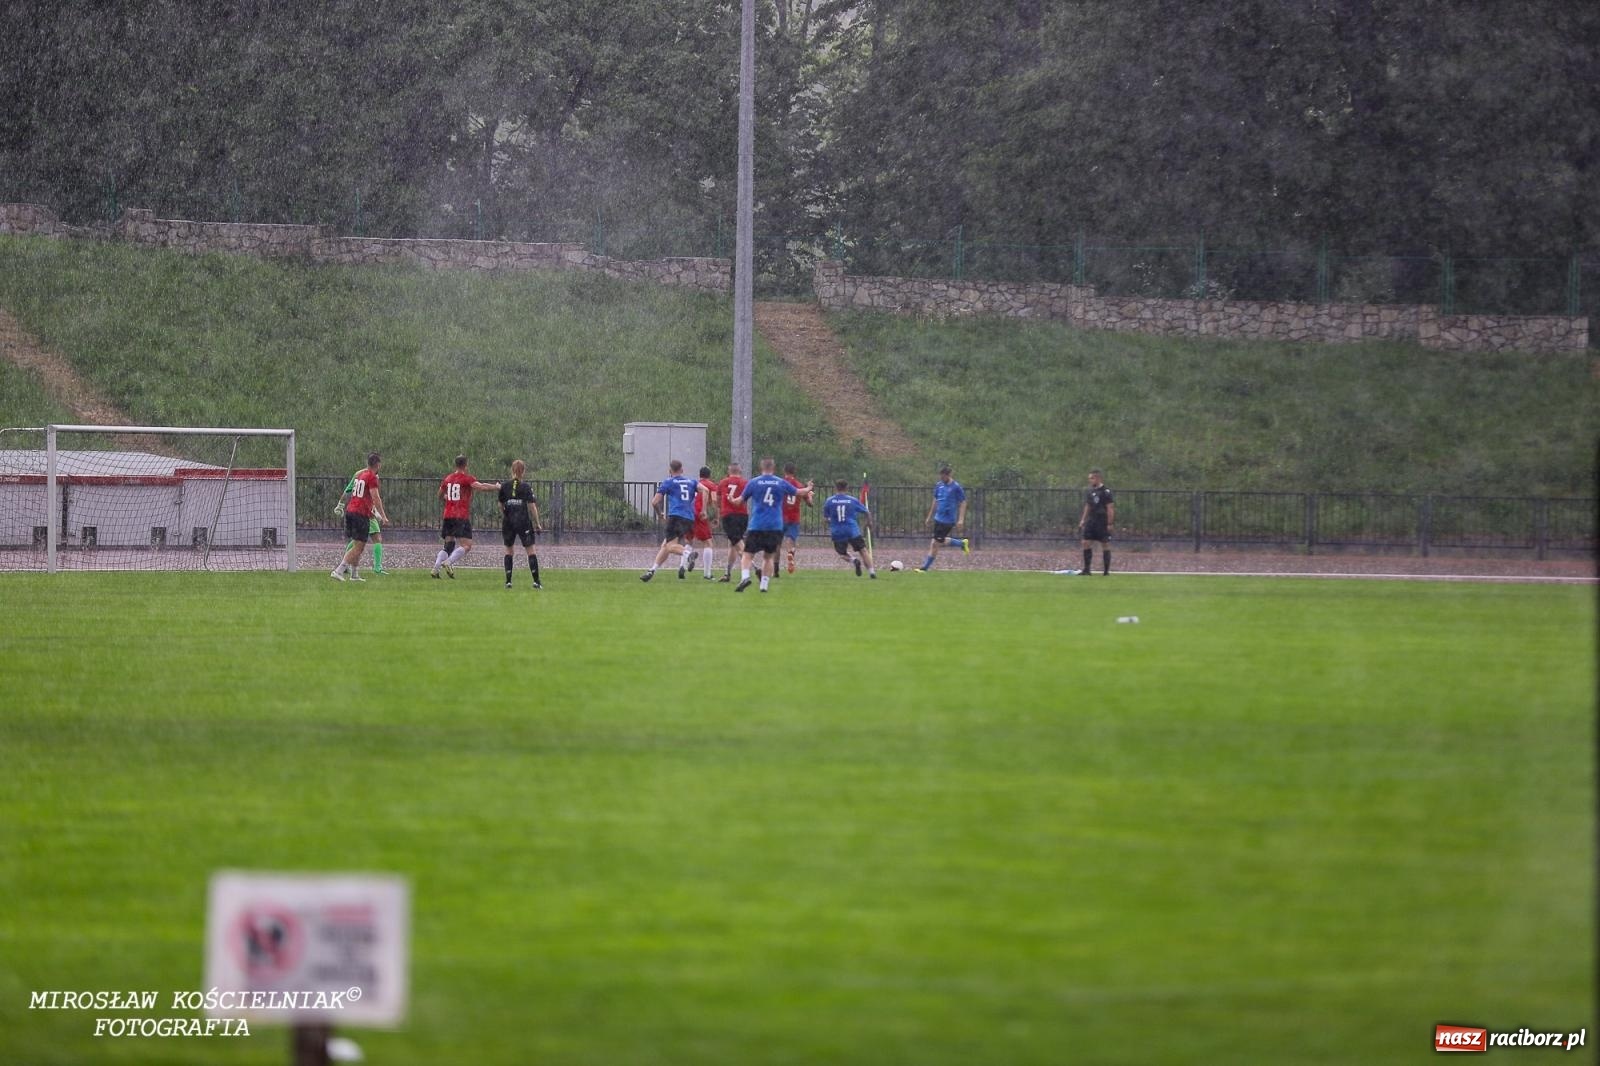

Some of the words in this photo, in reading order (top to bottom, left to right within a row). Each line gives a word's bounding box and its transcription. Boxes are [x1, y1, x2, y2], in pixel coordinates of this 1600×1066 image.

[446, 482, 461, 501] 18
[679, 484, 690, 501] 5
[727, 484, 738, 500] 7
[763, 486, 775, 507] 4
[836, 504, 846, 522] 11
